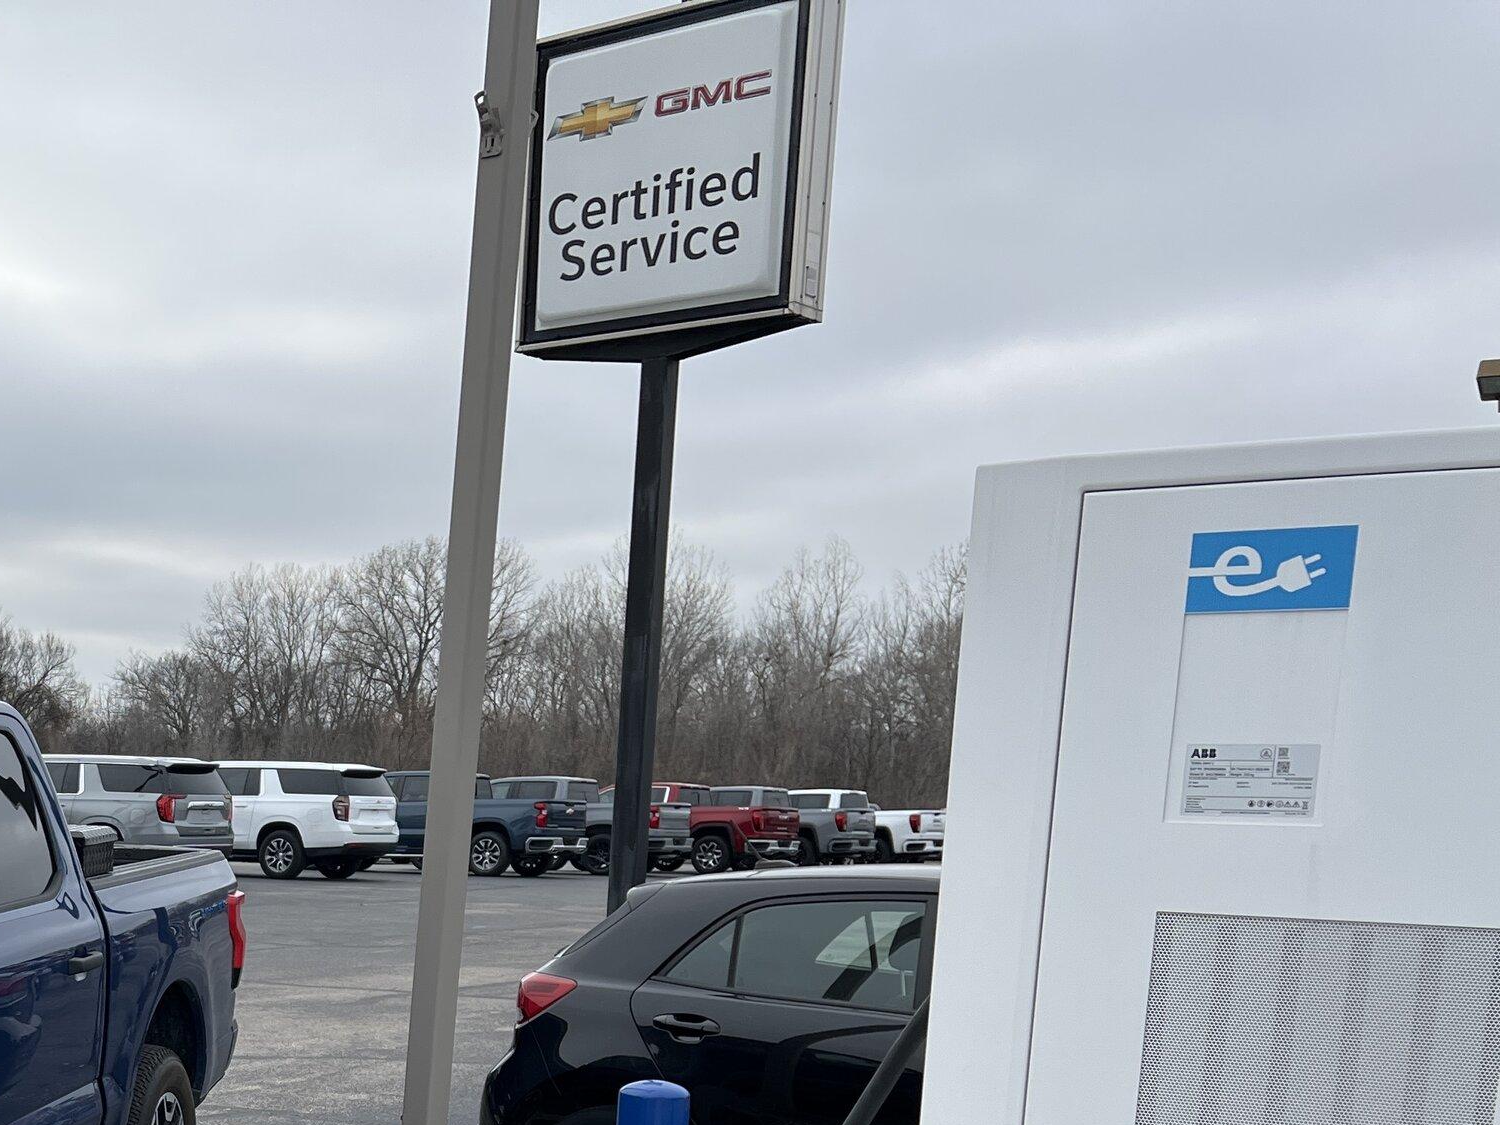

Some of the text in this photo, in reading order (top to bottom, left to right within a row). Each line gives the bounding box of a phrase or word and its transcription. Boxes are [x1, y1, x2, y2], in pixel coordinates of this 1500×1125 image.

[654, 70, 772, 117] GMC
[548, 152, 762, 235] Certified
[560, 219, 740, 281] Service
[1191, 748, 1217, 758] ABB
